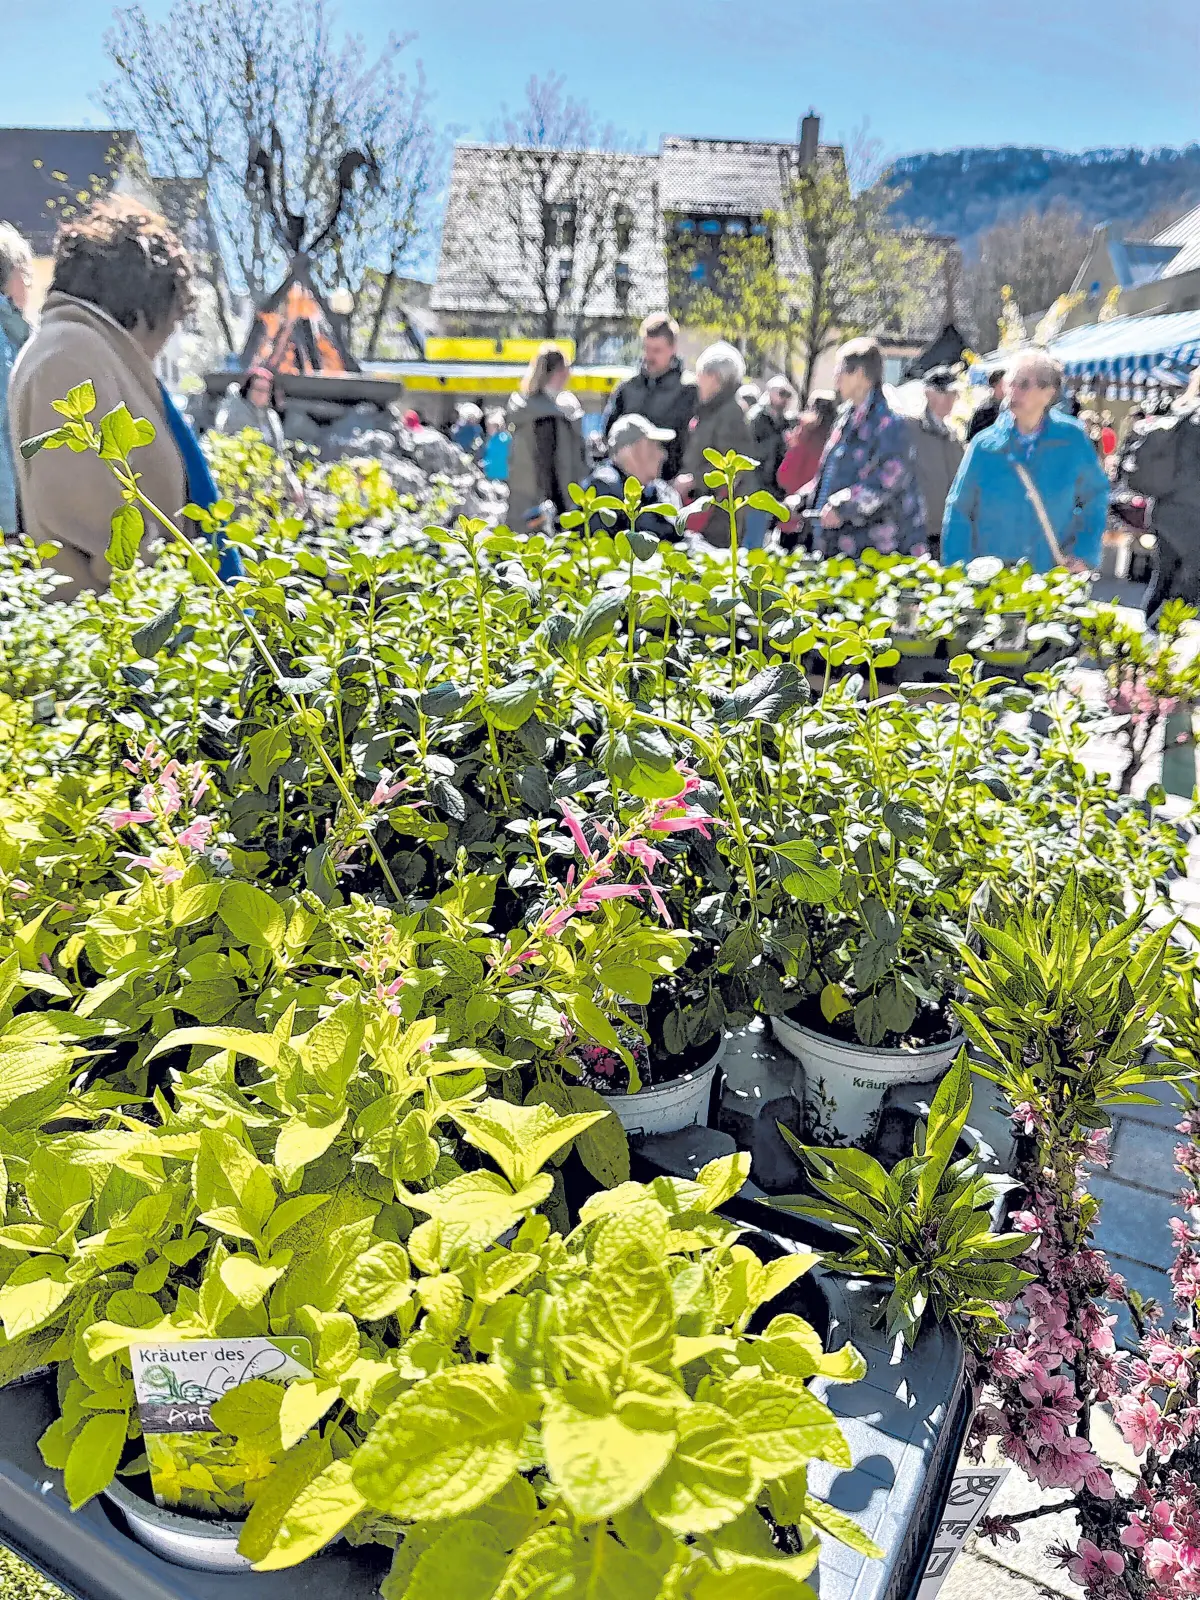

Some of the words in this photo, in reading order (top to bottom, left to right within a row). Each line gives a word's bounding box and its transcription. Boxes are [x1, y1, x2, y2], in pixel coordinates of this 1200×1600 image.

[139, 1348, 208, 1363] Kräuter
[214, 1346, 245, 1361] des
[291, 1344, 301, 1356] C
[166, 1406, 212, 1426] Apf
